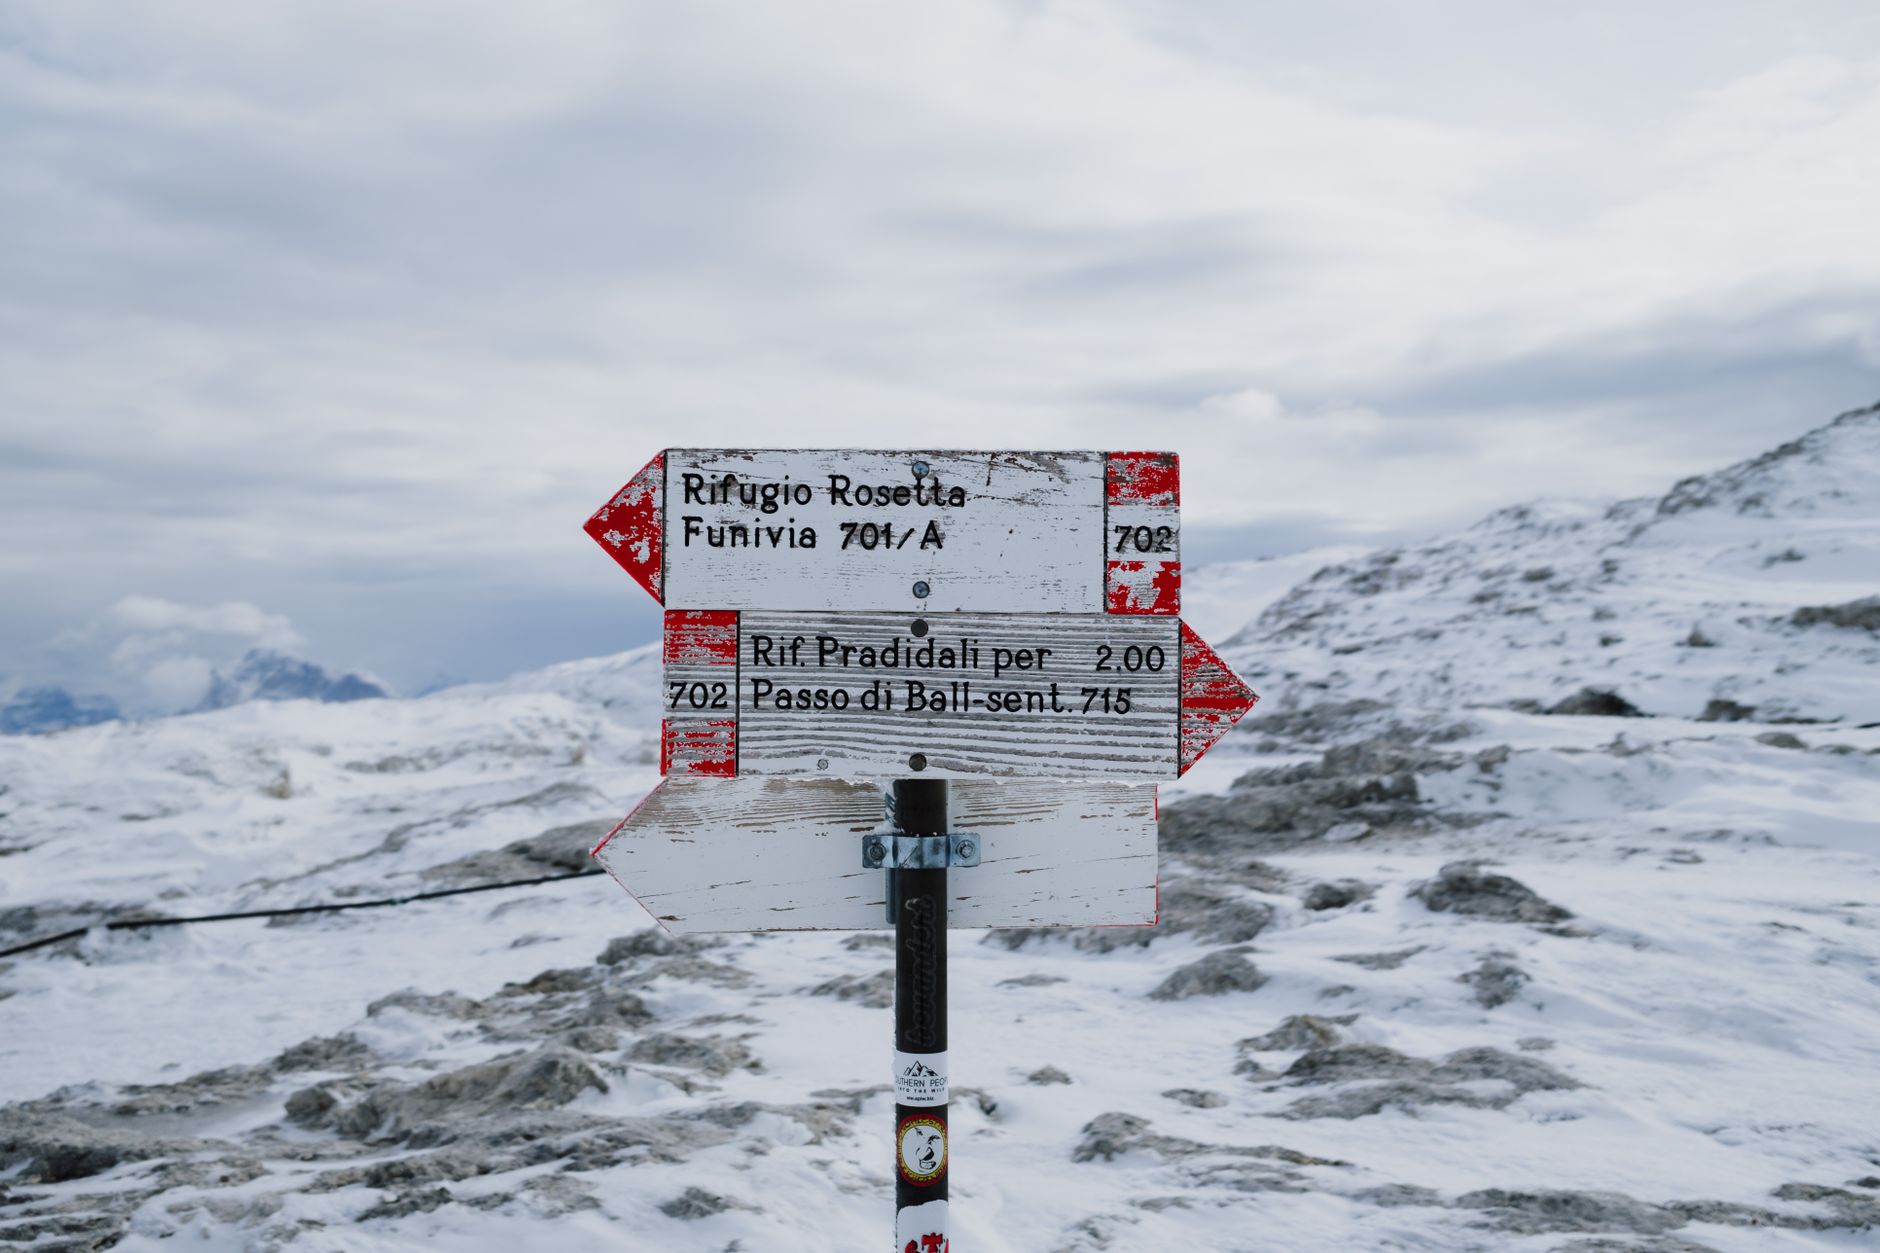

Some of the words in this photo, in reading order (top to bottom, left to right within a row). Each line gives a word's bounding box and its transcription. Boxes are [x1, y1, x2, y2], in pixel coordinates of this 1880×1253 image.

[682, 473, 812, 514] Rifugio
[828, 475, 966, 507] Rosetta
[682, 516, 817, 549] Funivia
[840, 520, 943, 550] 701/A
[1114, 525, 1173, 553] 702
[751, 635, 806, 667] Rif.
[816, 636, 979, 669] Pradidali
[992, 647, 1052, 678] per
[1096, 644, 1165, 672] 2.00
[670, 682, 728, 709] 702
[751, 678, 850, 710] Passo
[861, 680, 893, 711] di
[1081, 687, 1131, 714] 715
